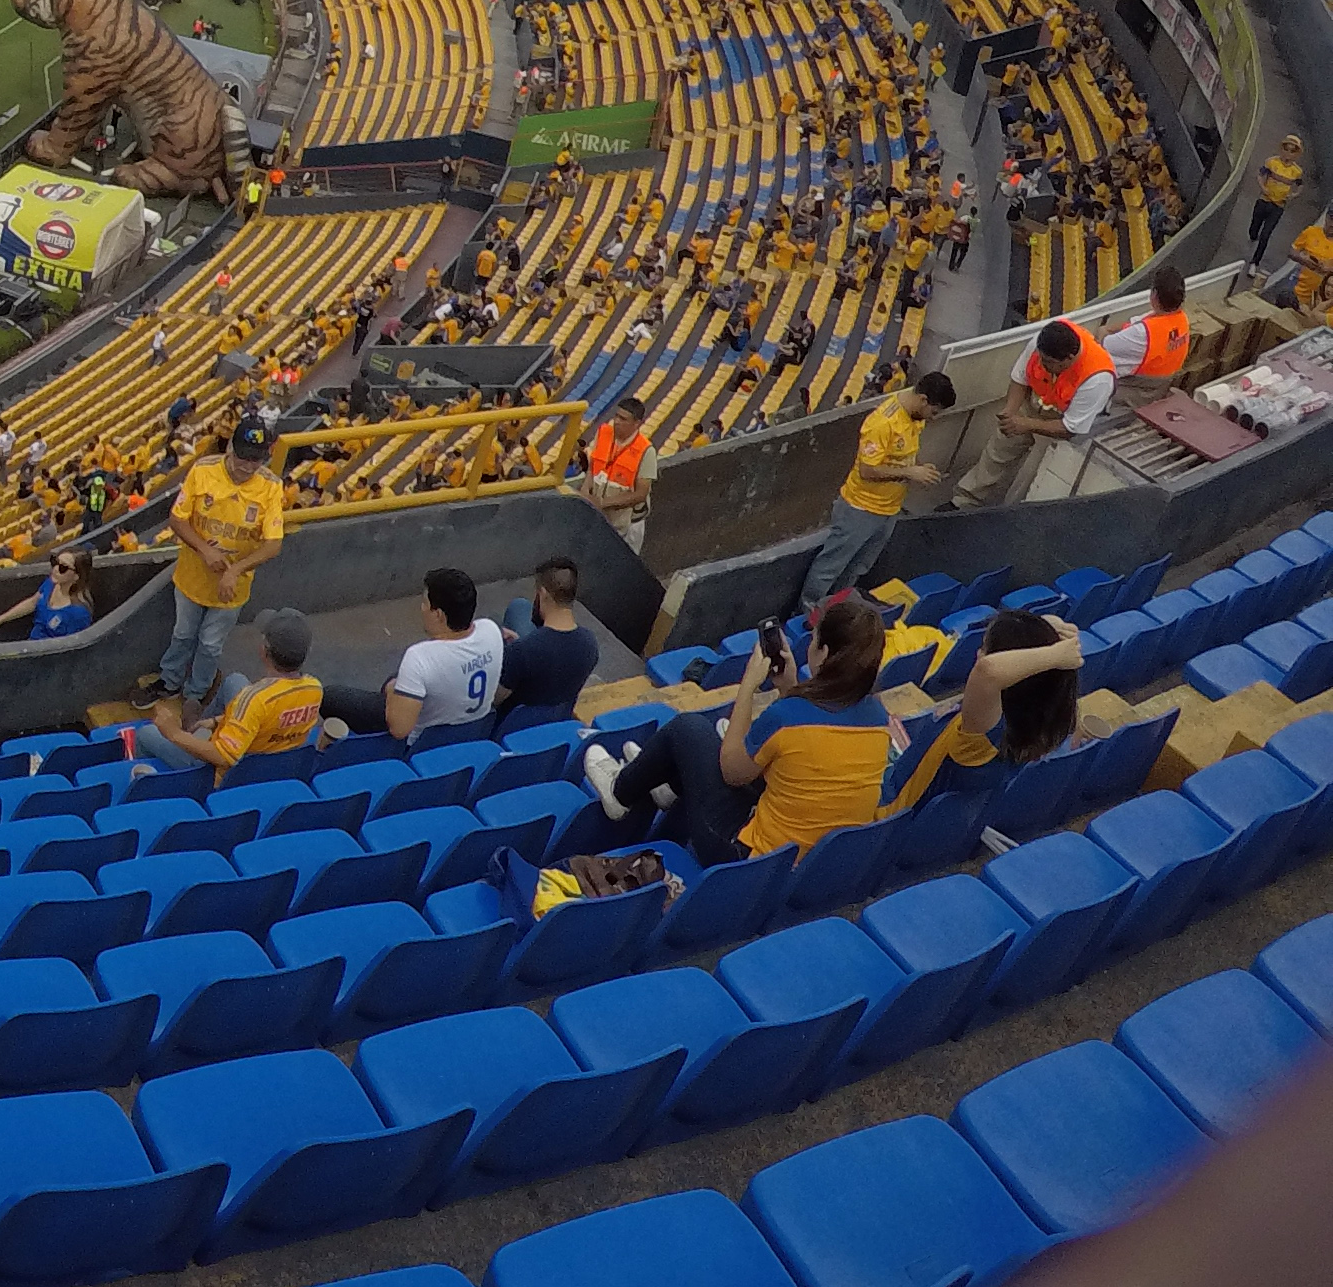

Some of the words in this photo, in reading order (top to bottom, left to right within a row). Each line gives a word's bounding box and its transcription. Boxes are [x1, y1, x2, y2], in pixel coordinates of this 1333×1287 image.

[556, 130, 631, 154] AFIRME
[36, 229, 75, 249] MONTERREY
[13, 255, 83, 291] EXTRA
[460, 650, 494, 676] VARGAS
[465, 669, 487, 714] 9
